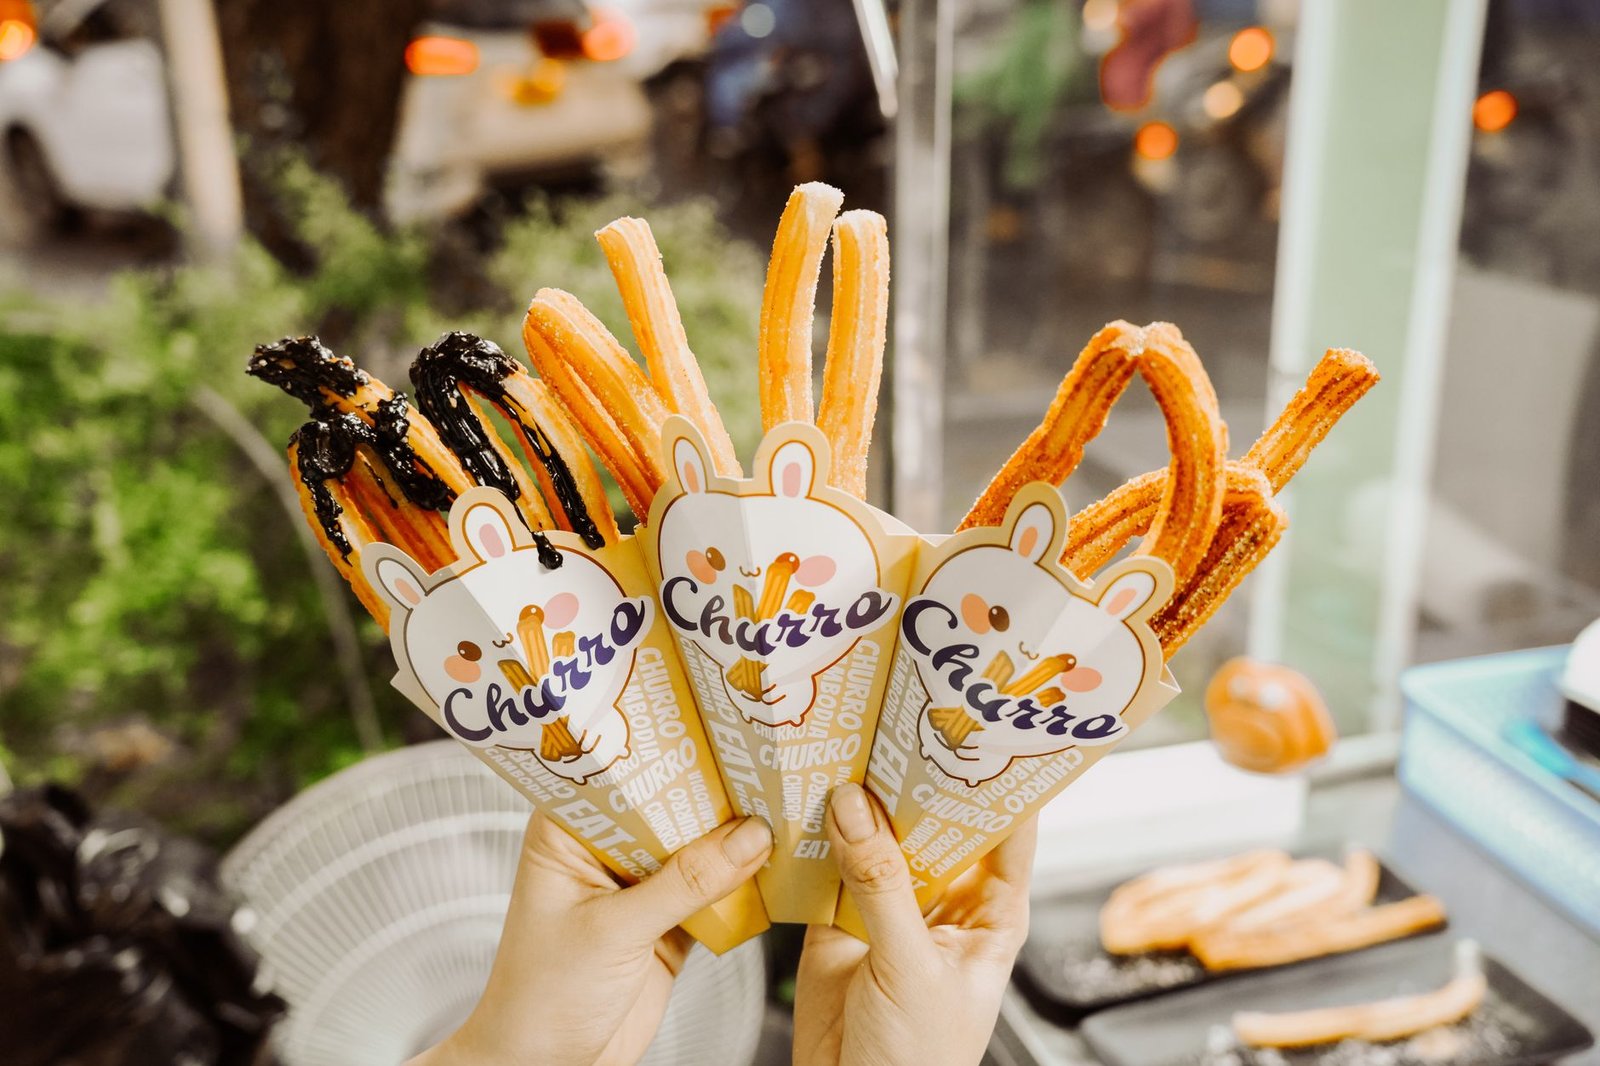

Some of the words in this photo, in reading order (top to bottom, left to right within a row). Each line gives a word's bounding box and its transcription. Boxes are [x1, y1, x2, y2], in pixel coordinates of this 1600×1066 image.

[663, 577, 892, 656] Churro
[444, 600, 645, 741] Churro
[638, 647, 687, 738] CHURRO
[808, 659, 848, 738] MBODIA
[842, 640, 880, 730] CHURRO
[902, 599, 1123, 739] Churro
[624, 672, 661, 762] MBODIA
[608, 737, 697, 813] CHURRO
[708, 720, 764, 792] EAT
[760, 733, 861, 771] CHURRO
[866, 729, 908, 816] EAT
[972, 756, 1051, 808] MBODIA
[1004, 748, 1084, 813] CHURRO
[552, 799, 637, 850] EAT
[643, 801, 681, 849] CHURRO
[667, 788, 702, 843] HURRO
[782, 774, 802, 820] CHURRO
[801, 772, 829, 833] CHURRO
[912, 784, 1014, 832] CHURRO
[901, 817, 942, 855] CHURRO
[910, 827, 963, 871] CHURRO
[929, 833, 987, 878] CAMBODIA
